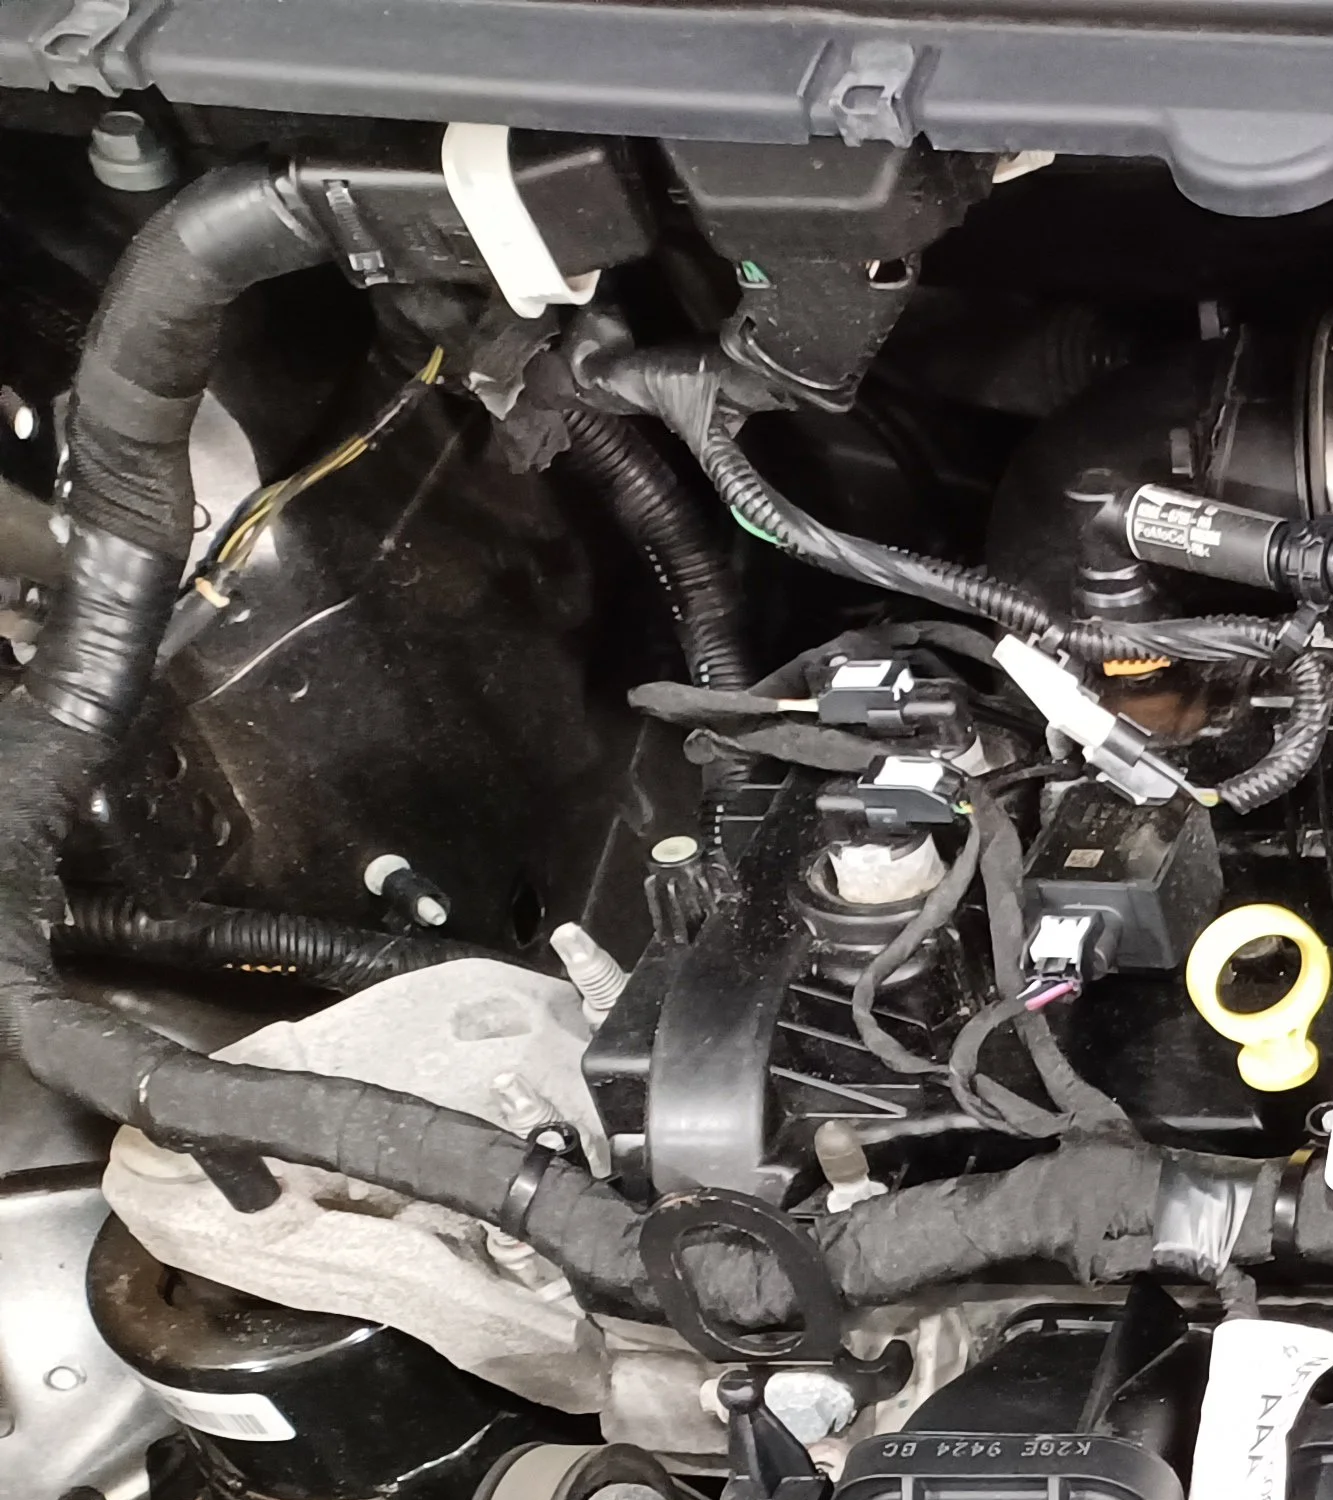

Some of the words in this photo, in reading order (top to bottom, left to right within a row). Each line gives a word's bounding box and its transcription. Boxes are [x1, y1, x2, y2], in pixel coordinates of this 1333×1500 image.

[881, 1442, 918, 1458] BC
[936, 1441, 1001, 1457] 9424
[1020, 1441, 1091, 1457] K2GE
